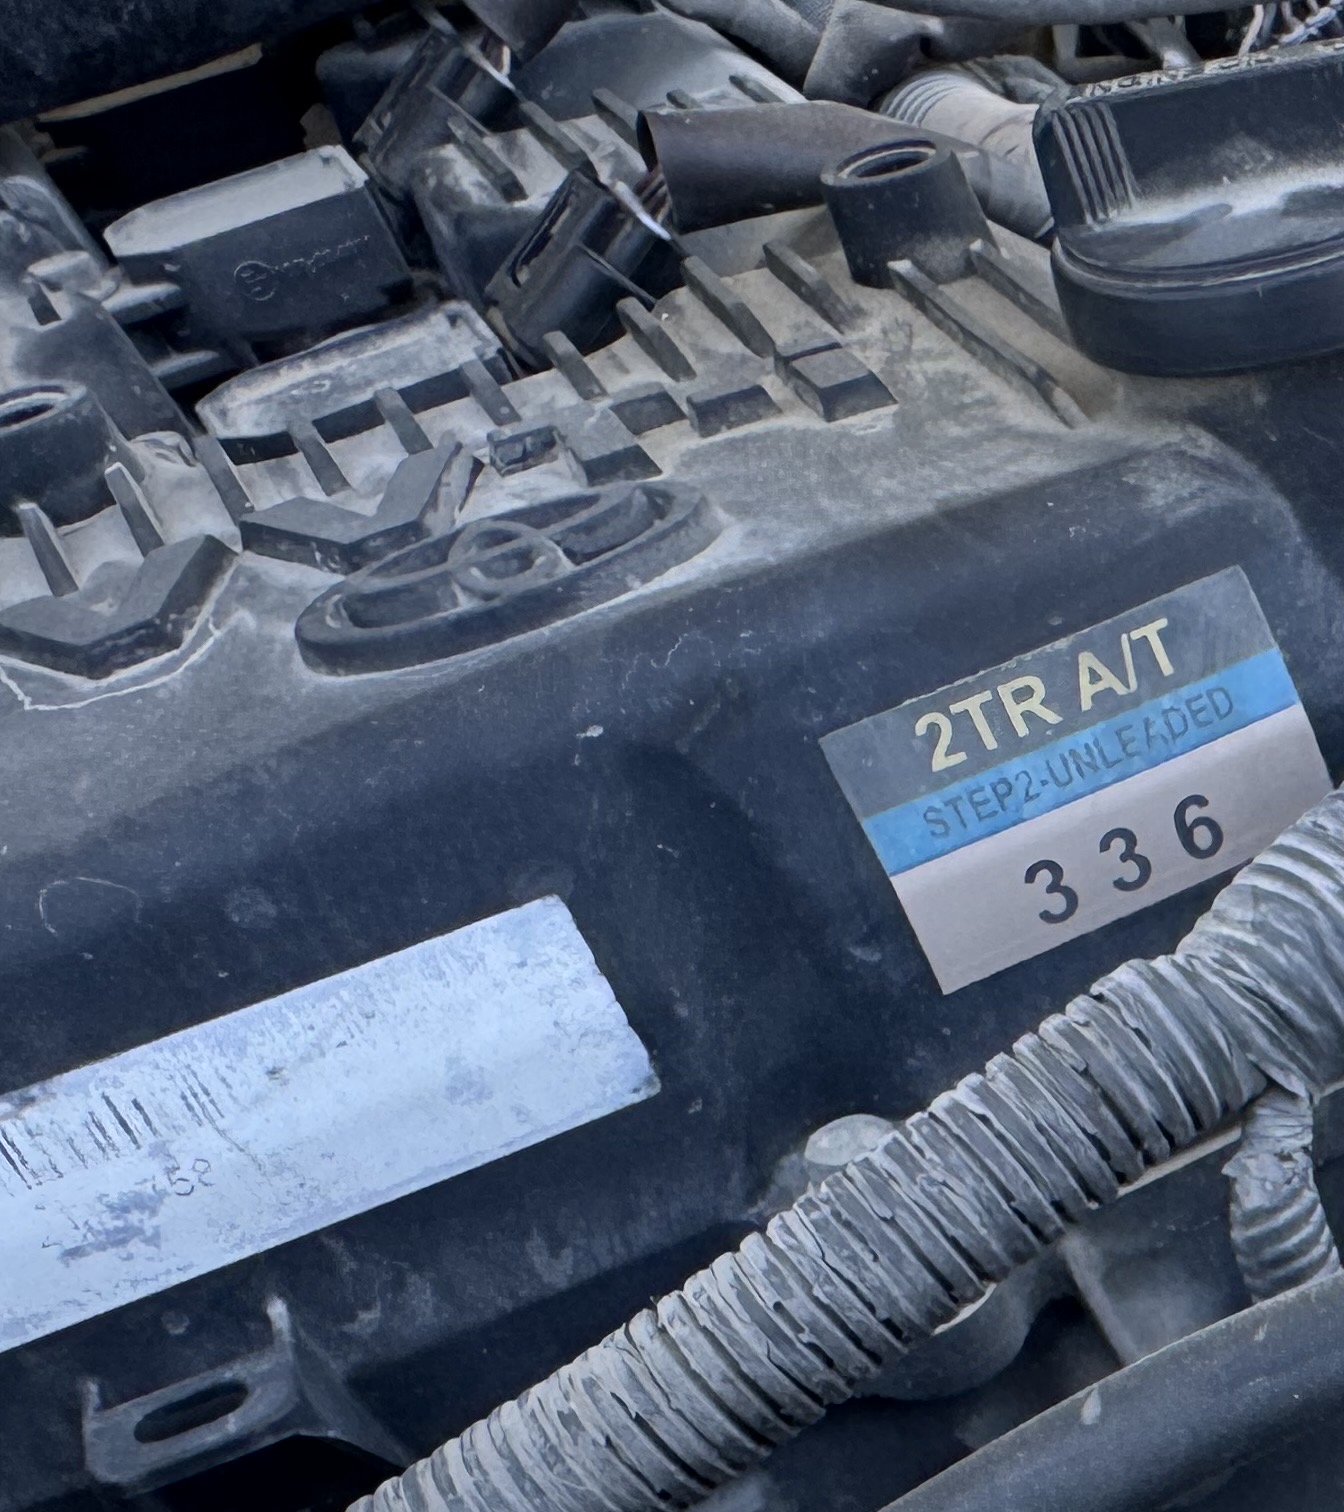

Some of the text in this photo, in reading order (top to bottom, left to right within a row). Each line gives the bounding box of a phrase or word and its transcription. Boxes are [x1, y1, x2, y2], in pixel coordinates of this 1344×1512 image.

[914, 617, 1175, 773] 2TR A/T
[922, 685, 1235, 839] STEP2-UNLEADED
